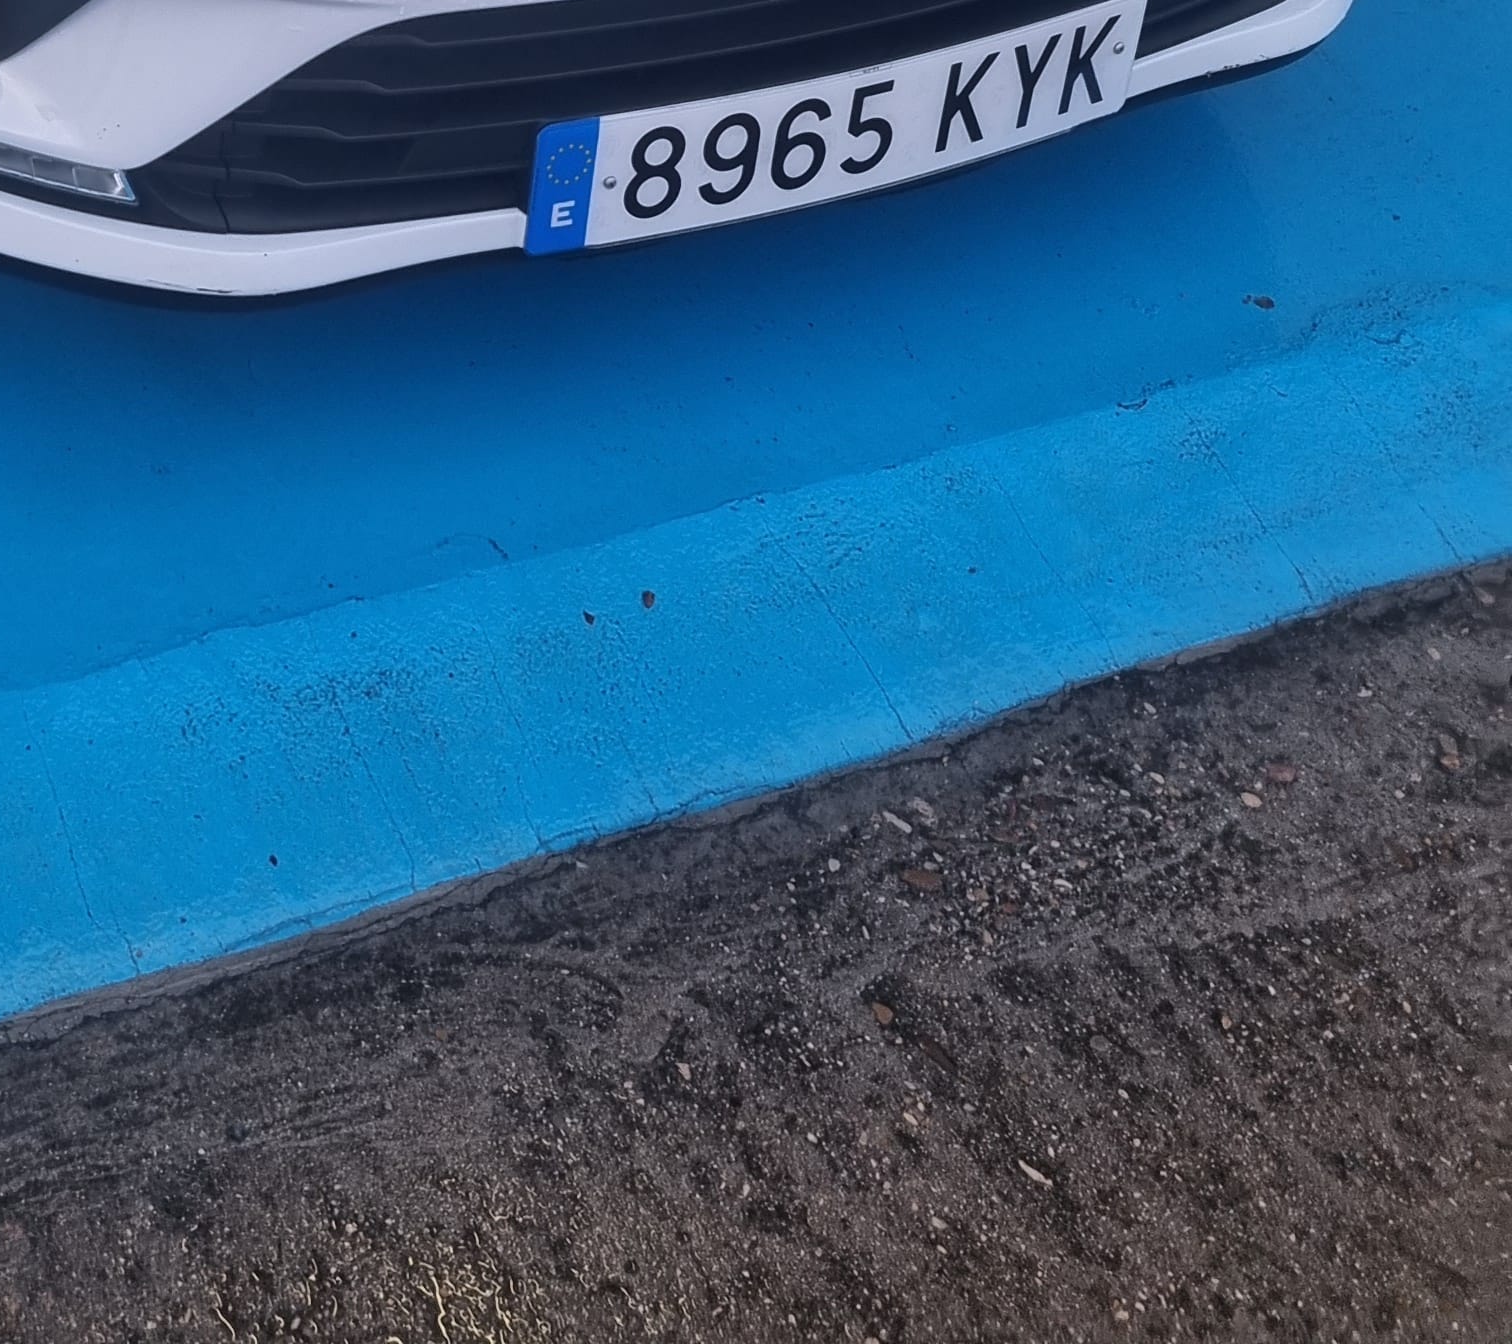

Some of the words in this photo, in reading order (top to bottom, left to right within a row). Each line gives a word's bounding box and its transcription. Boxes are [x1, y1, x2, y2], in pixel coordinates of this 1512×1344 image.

[622, 78, 896, 220] 8965
[933, 13, 1122, 154] KYK
[550, 199, 576, 228] E
